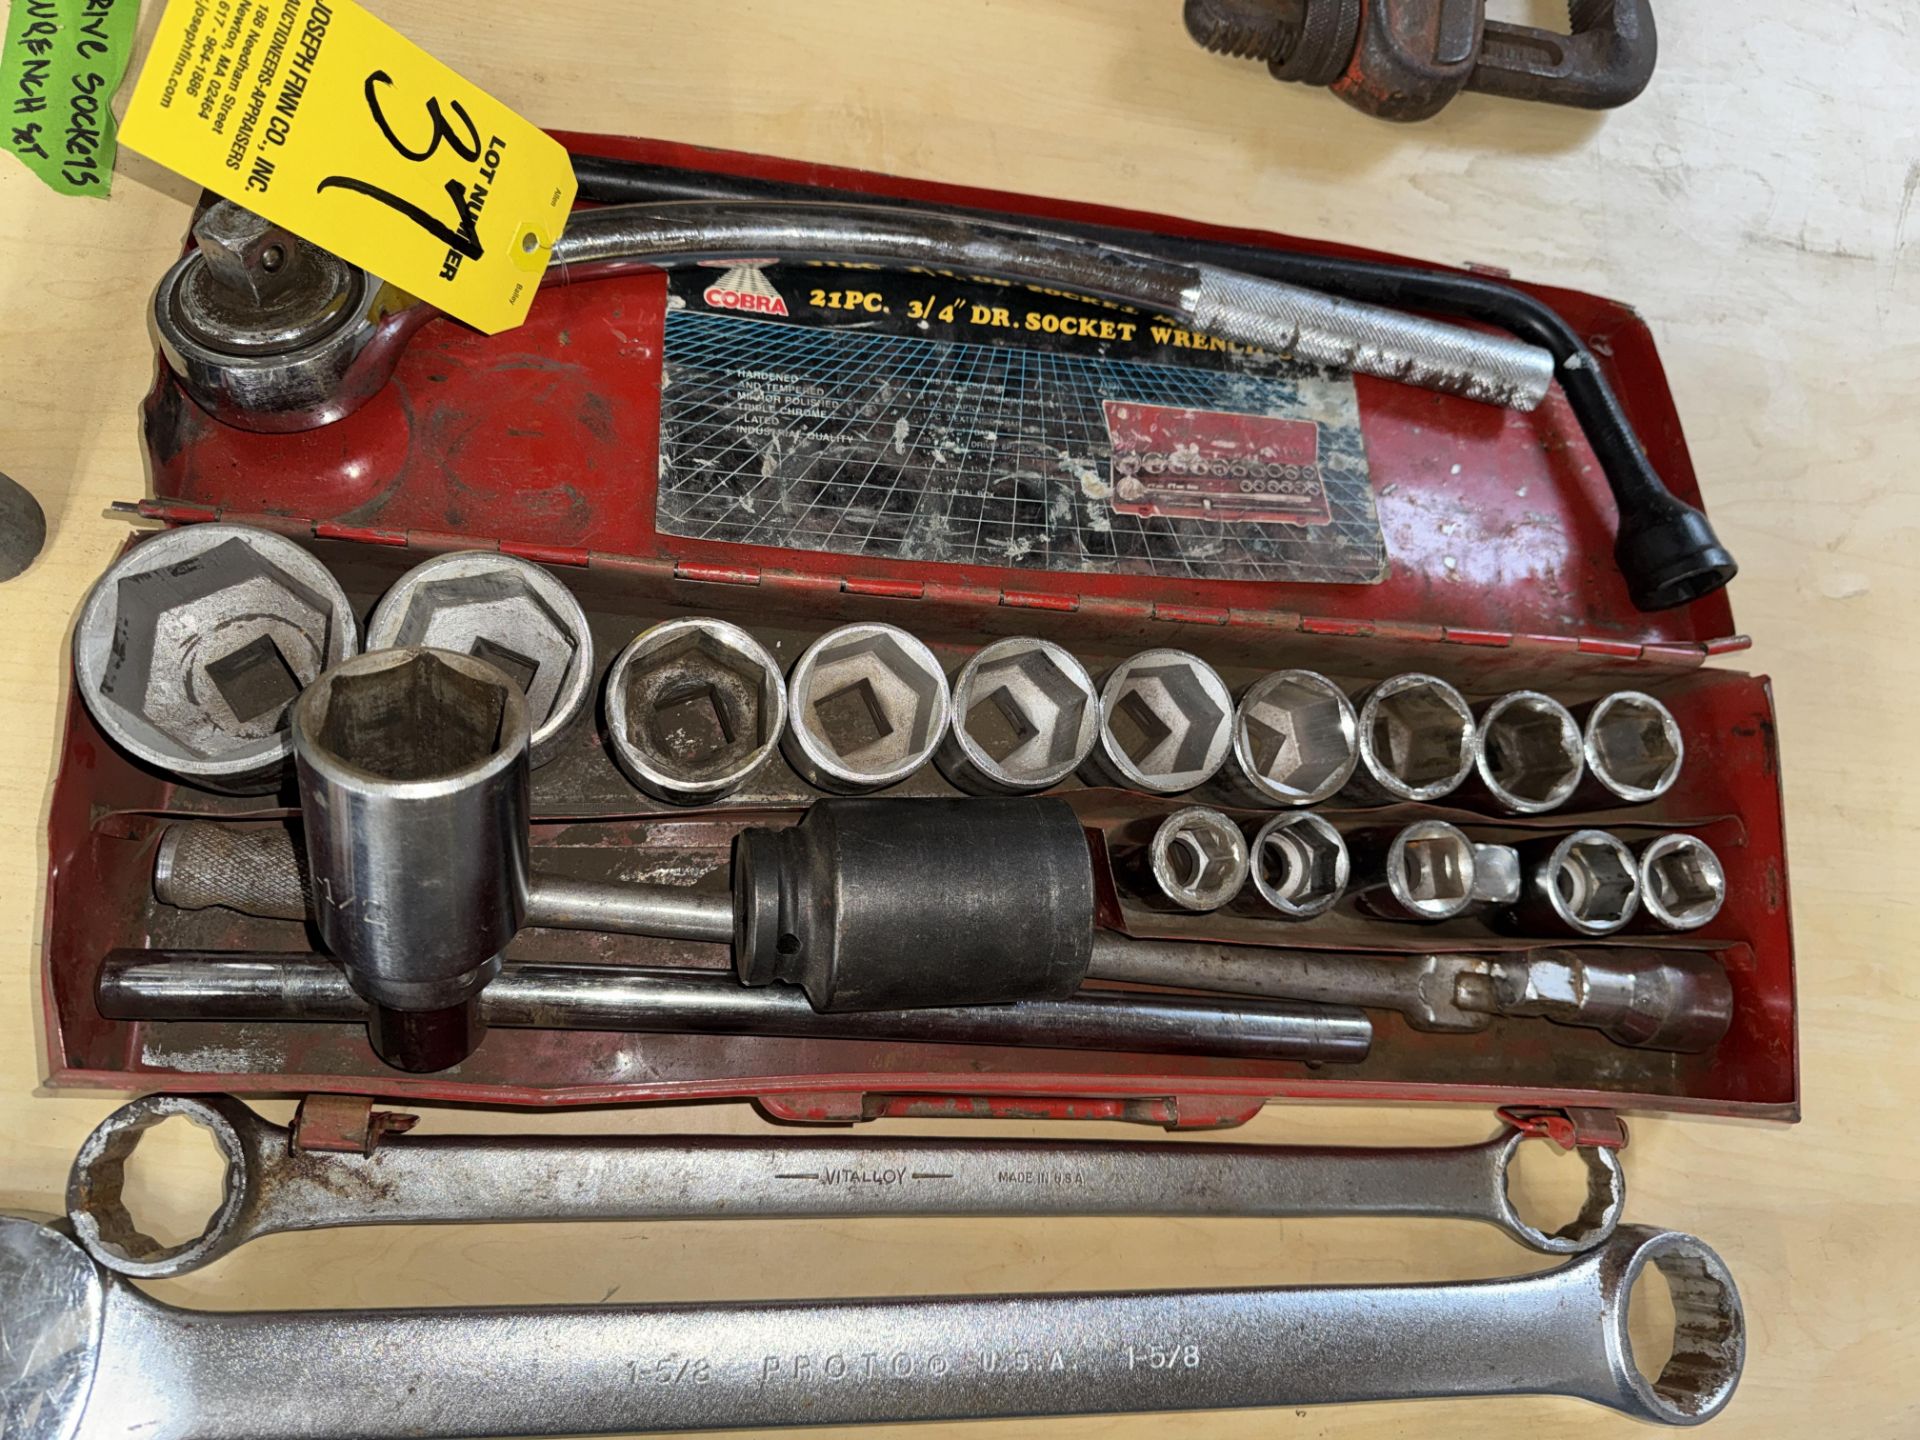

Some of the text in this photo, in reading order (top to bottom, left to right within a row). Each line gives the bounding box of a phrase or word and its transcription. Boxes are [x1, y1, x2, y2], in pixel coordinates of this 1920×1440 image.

[213, 0, 231, 28] 617
[292, 0, 333, 74] JOSEPH
[186, 35, 218, 98] 964-1886
[197, 0, 253, 121] Newton, MA 02464
[211, 4, 269, 136] 188 Needham Street
[275, 68, 308, 119] FINN
[245, 156, 276, 193] INC.
[438, 135, 507, 282] LOT NUMER
[704, 288, 789, 316] COBRA
[809, 288, 891, 315] 21PC.
[970, 305, 1020, 329] DR.
[1025, 312, 1137, 342] SOCKET
[737, 369, 800, 383] HARDENED
[738, 380, 825, 396] AND TEMPERED
[784, 397, 840, 410] POLISHED
[822, 1167, 907, 1185] VITALLOY
[998, 1171, 1032, 1184] MADE
[1037, 1171, 1050, 1184] IN
[1124, 1344, 1200, 1371] 1-5/8
